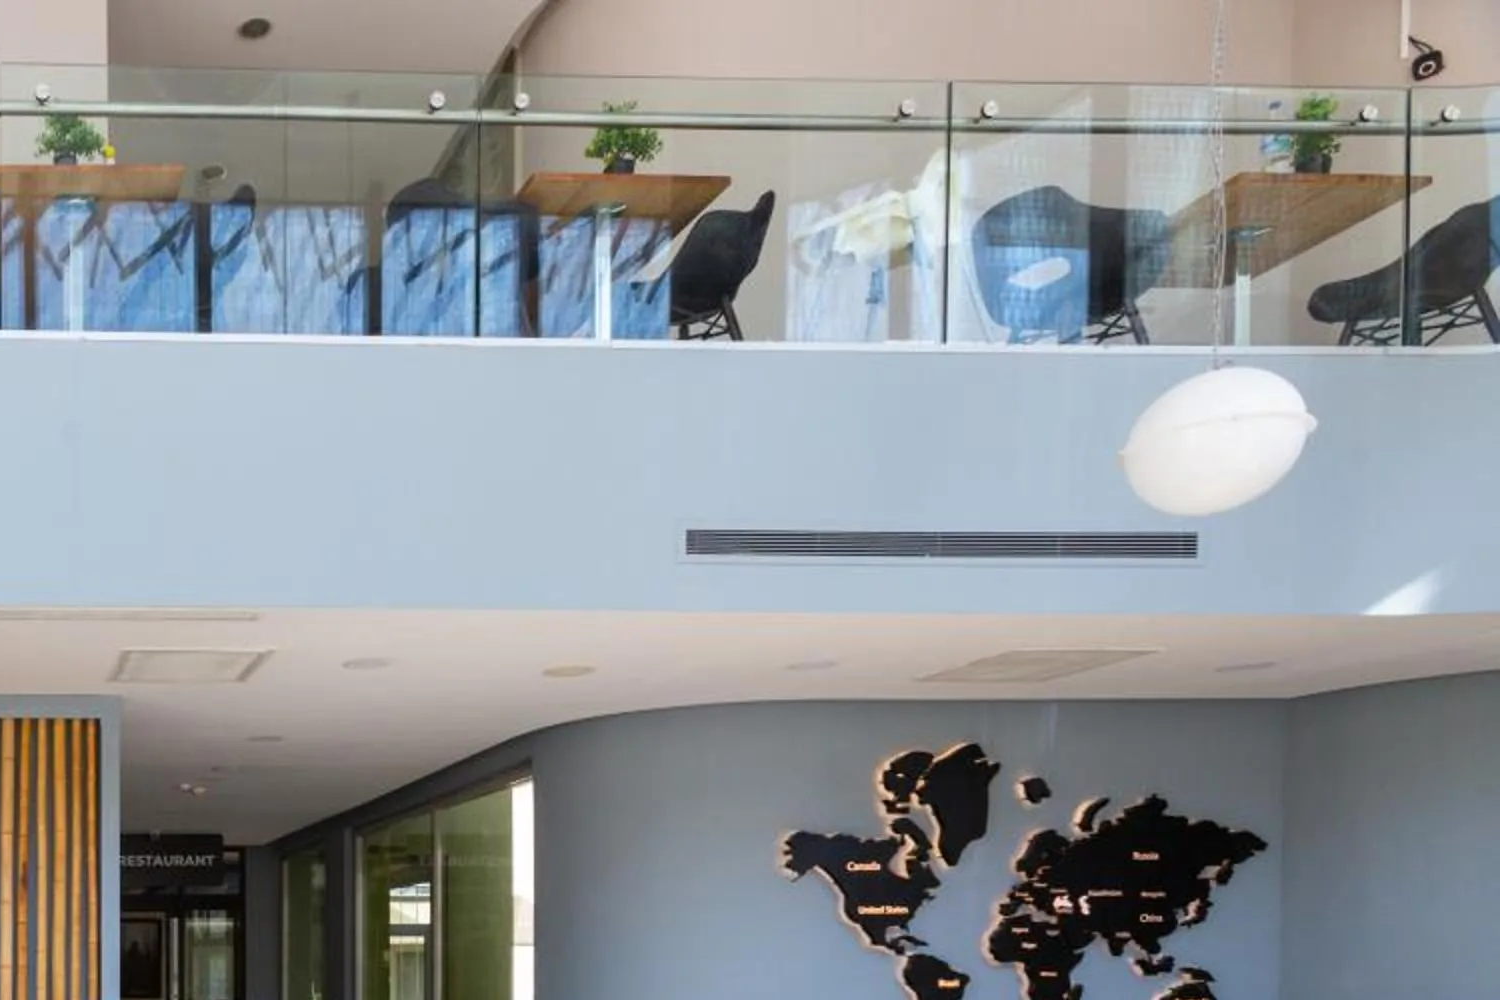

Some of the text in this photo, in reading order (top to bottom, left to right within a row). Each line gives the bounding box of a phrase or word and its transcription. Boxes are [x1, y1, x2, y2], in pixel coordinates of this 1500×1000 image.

[118, 854, 215, 867] RESTAURANT
[846, 861, 881, 871] Canada
[1140, 913, 1164, 923] China
